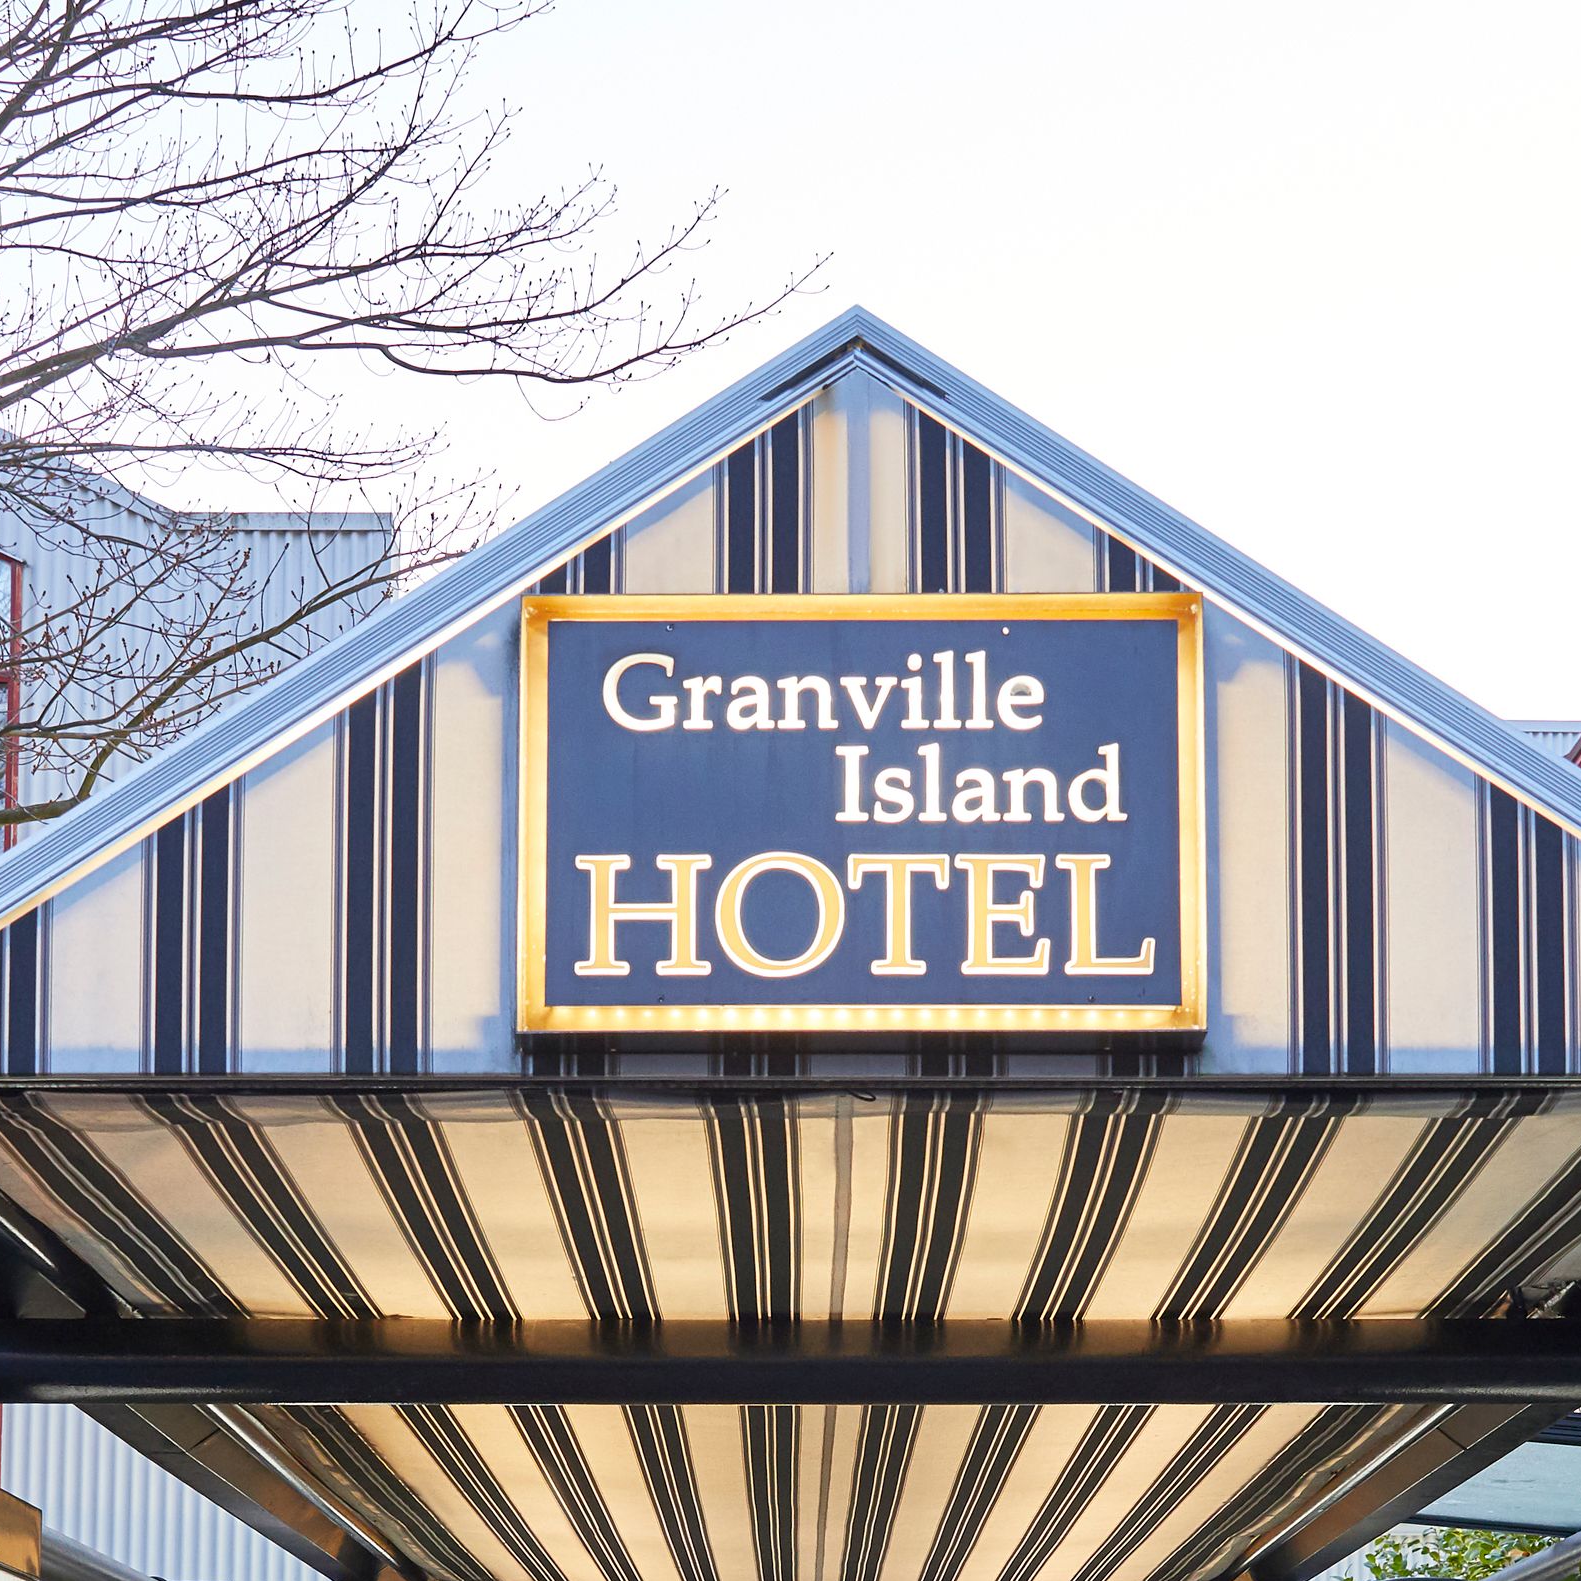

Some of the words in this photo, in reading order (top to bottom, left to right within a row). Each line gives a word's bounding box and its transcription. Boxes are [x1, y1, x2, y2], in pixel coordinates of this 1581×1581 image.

[602, 650, 1045, 732] Granville
[834, 742, 1128, 823] Island
[574, 850, 1157, 978] HOTEL
